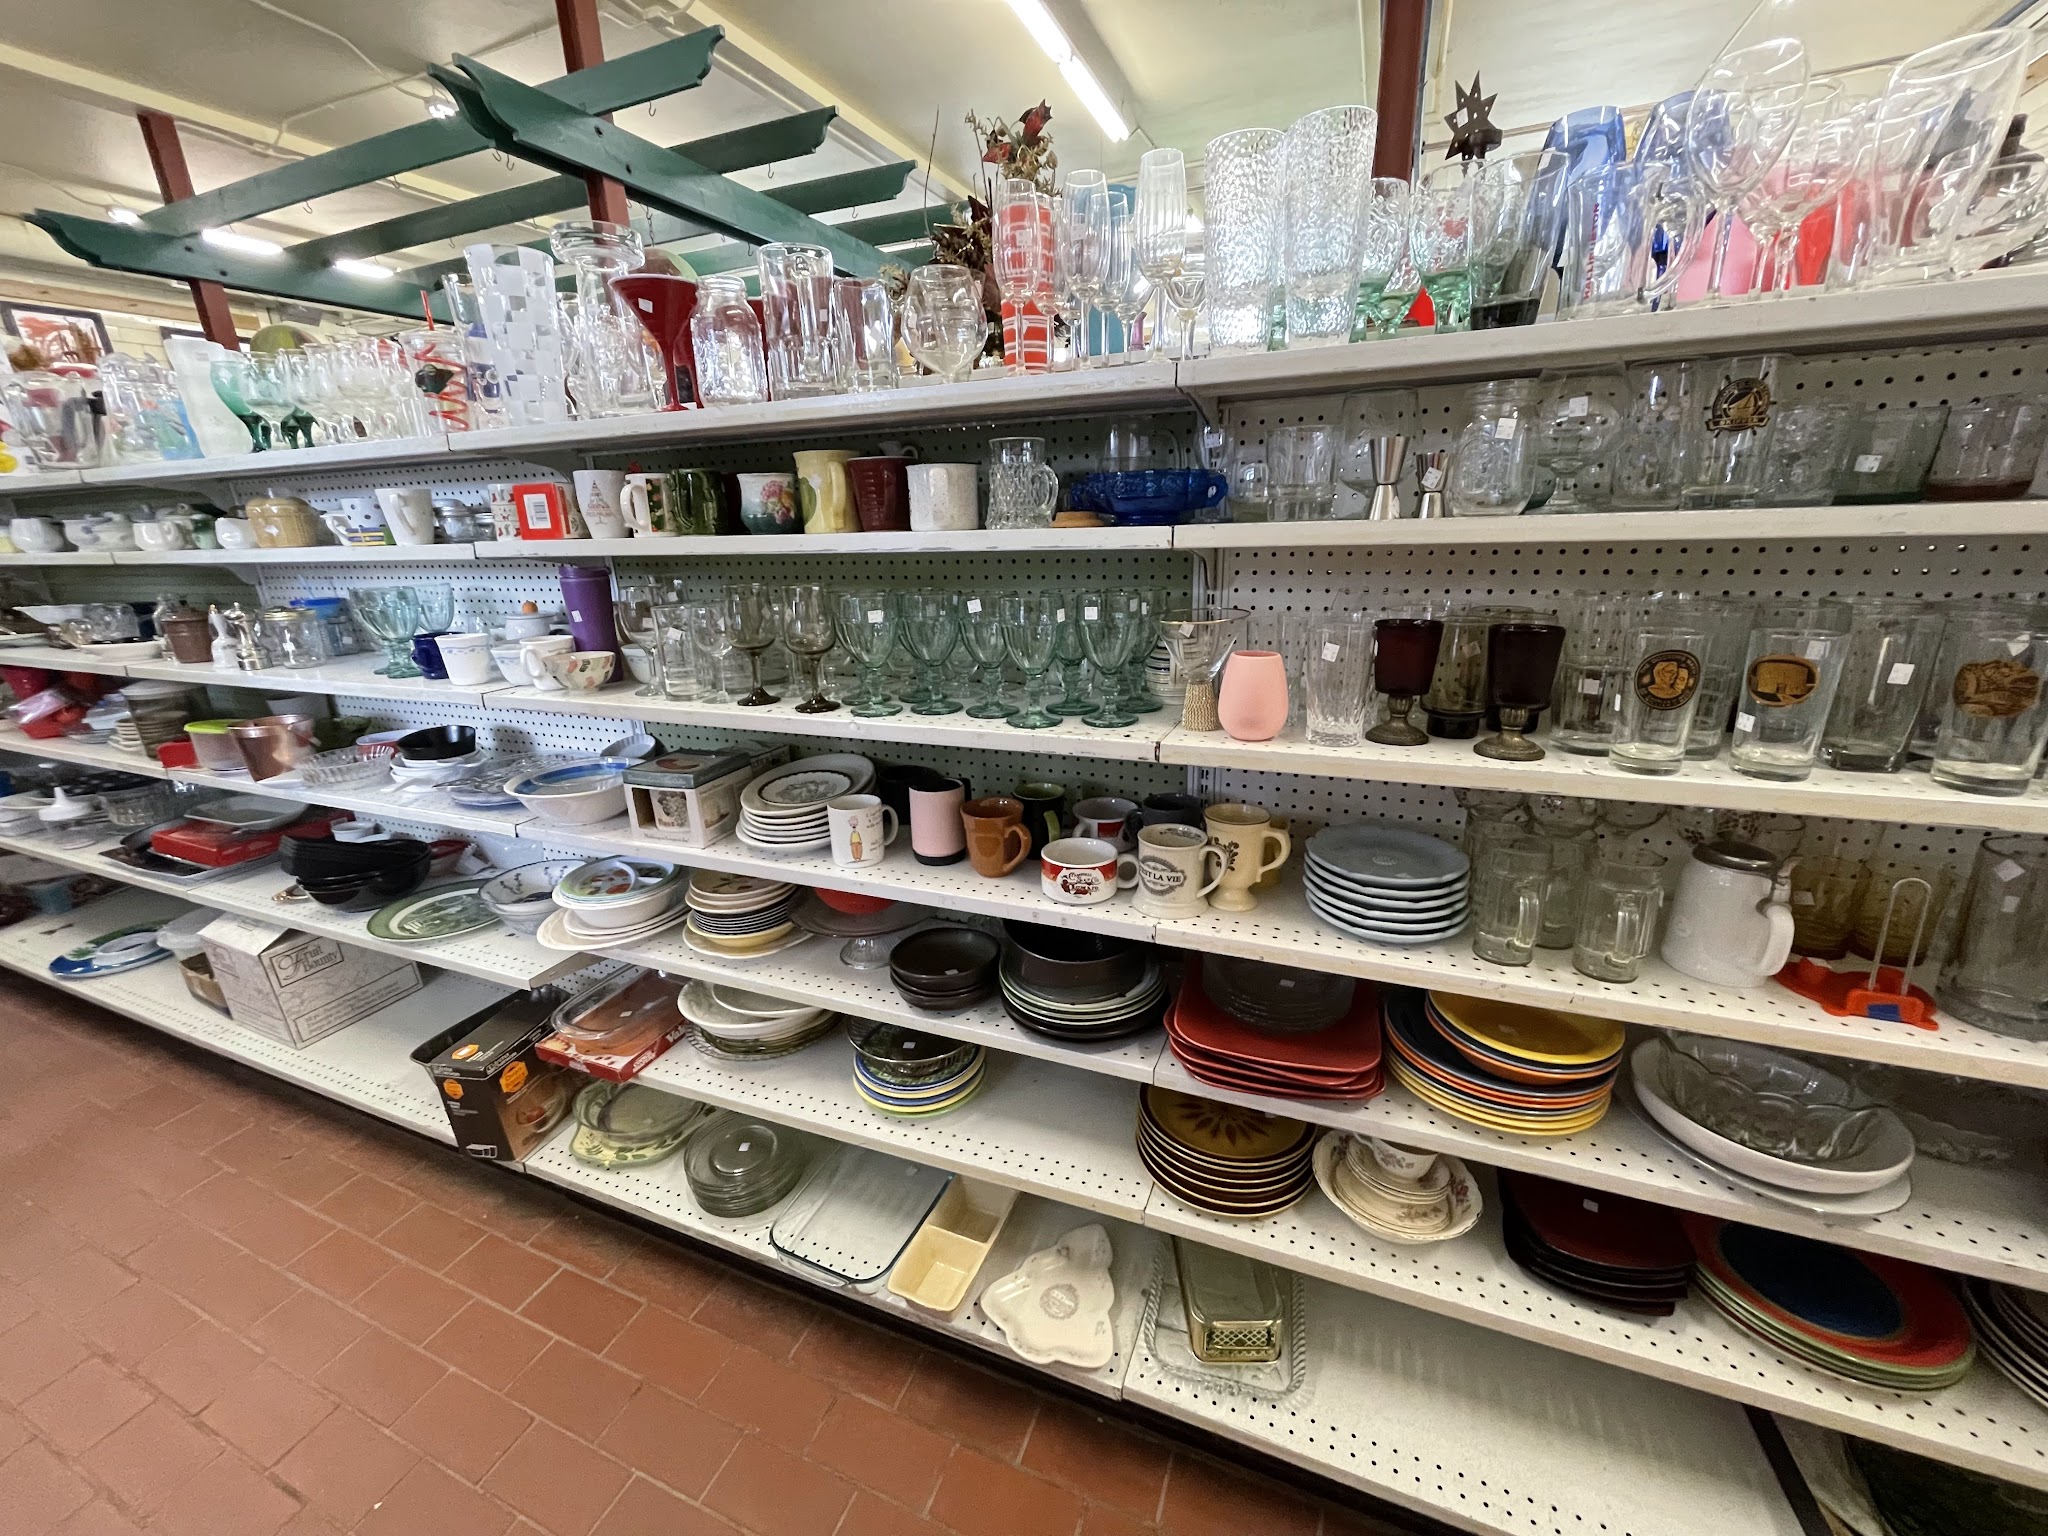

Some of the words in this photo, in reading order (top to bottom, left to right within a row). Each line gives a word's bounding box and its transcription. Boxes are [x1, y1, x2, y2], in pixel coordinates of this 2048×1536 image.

[1153, 873, 1164, 882] LA
[1166, 875, 1182, 883] VIE
[278, 945, 324, 980] Fruit
